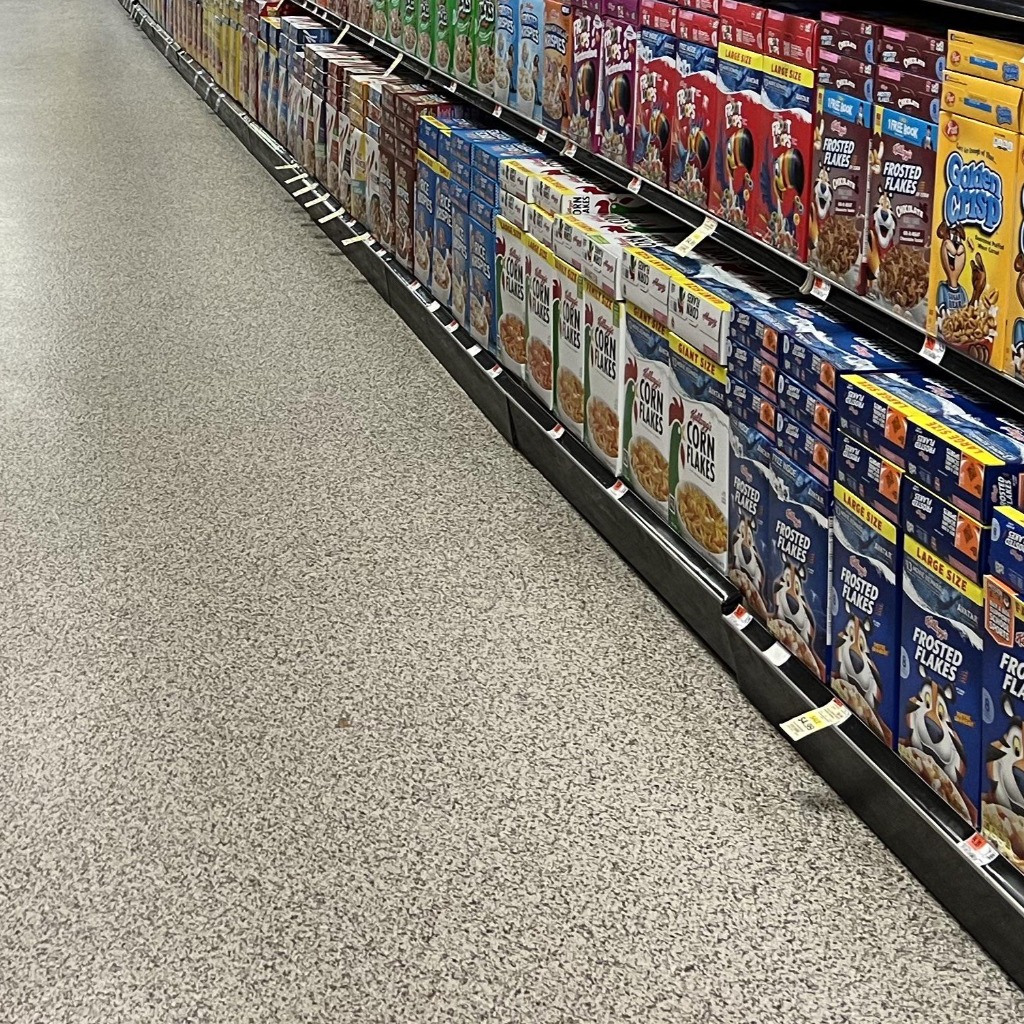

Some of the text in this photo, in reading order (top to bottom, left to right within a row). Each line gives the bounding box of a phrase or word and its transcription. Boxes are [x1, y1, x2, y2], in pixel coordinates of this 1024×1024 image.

[725, 48, 752, 65] LARGE SIZE
[771, 63, 802, 81] LARGE SIZE
[822, 138, 855, 154] FROSTED
[904, 124, 919, 139] BOOK
[824, 152, 851, 168] FLAKES
[883, 162, 922, 180] FROSTED
[832, 177, 856, 190] CHOCOLATE
[885, 177, 918, 195] FLAKES
[946, 152, 1002, 199] Golden
[895, 204, 924, 219] CHOCOLATE
[506, 257, 523, 285] CORN
[506, 277, 524, 301] FLAKES
[532, 277, 550, 307] CORN
[532, 300, 550, 324] FLAKES
[562, 299, 581, 330] CORN
[634, 308, 666, 336] GIANT SIZE
[563, 325, 581, 350] FLAKES
[594, 327, 616, 359] CORN
[594, 349, 616, 380] FLAKES
[678, 343, 716, 376] GIANT SIZE
[639, 379, 664, 415] CORN
[639, 401, 664, 435] FLAKES
[686, 420, 715, 461] CORN
[925, 421, 984, 454] LARGE SIZE
[686, 444, 715, 483] FLAKES
[734, 476, 760, 503] FROSTED
[734, 490, 758, 515] FLAKES
[843, 492, 882, 531] LARGE SIZE
[775, 520, 811, 550] FROSTED
[777, 540, 807, 564] FLAKES
[840, 566, 879, 601] FROSTED
[916, 546, 968, 592] LARGE SIZE
[841, 586, 875, 615] FLAKES
[912, 626, 964, 667] FROSTED
[914, 647, 958, 682] FLAKES
